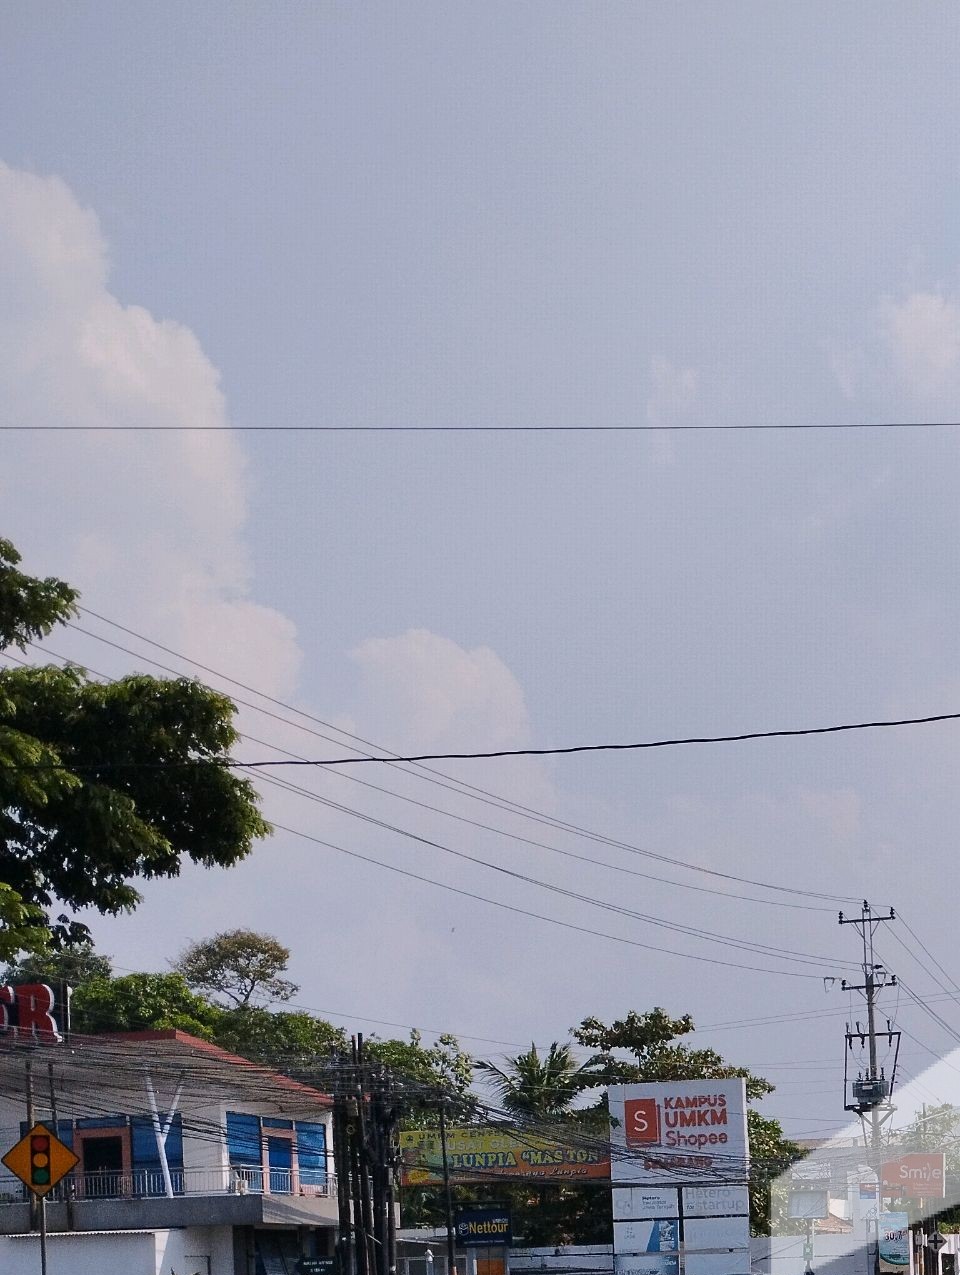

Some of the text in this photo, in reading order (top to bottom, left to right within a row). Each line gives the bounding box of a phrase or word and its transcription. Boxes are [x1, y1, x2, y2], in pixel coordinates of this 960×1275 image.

[663, 1094, 727, 1110] KAMPUS
[633, 1110, 649, 1132] S
[664, 1108, 728, 1128] UMKM
[665, 1130, 728, 1149] Shopee
[452, 1150, 517, 1168] LUNPIA
[468, 1220, 509, 1234] Nettour
